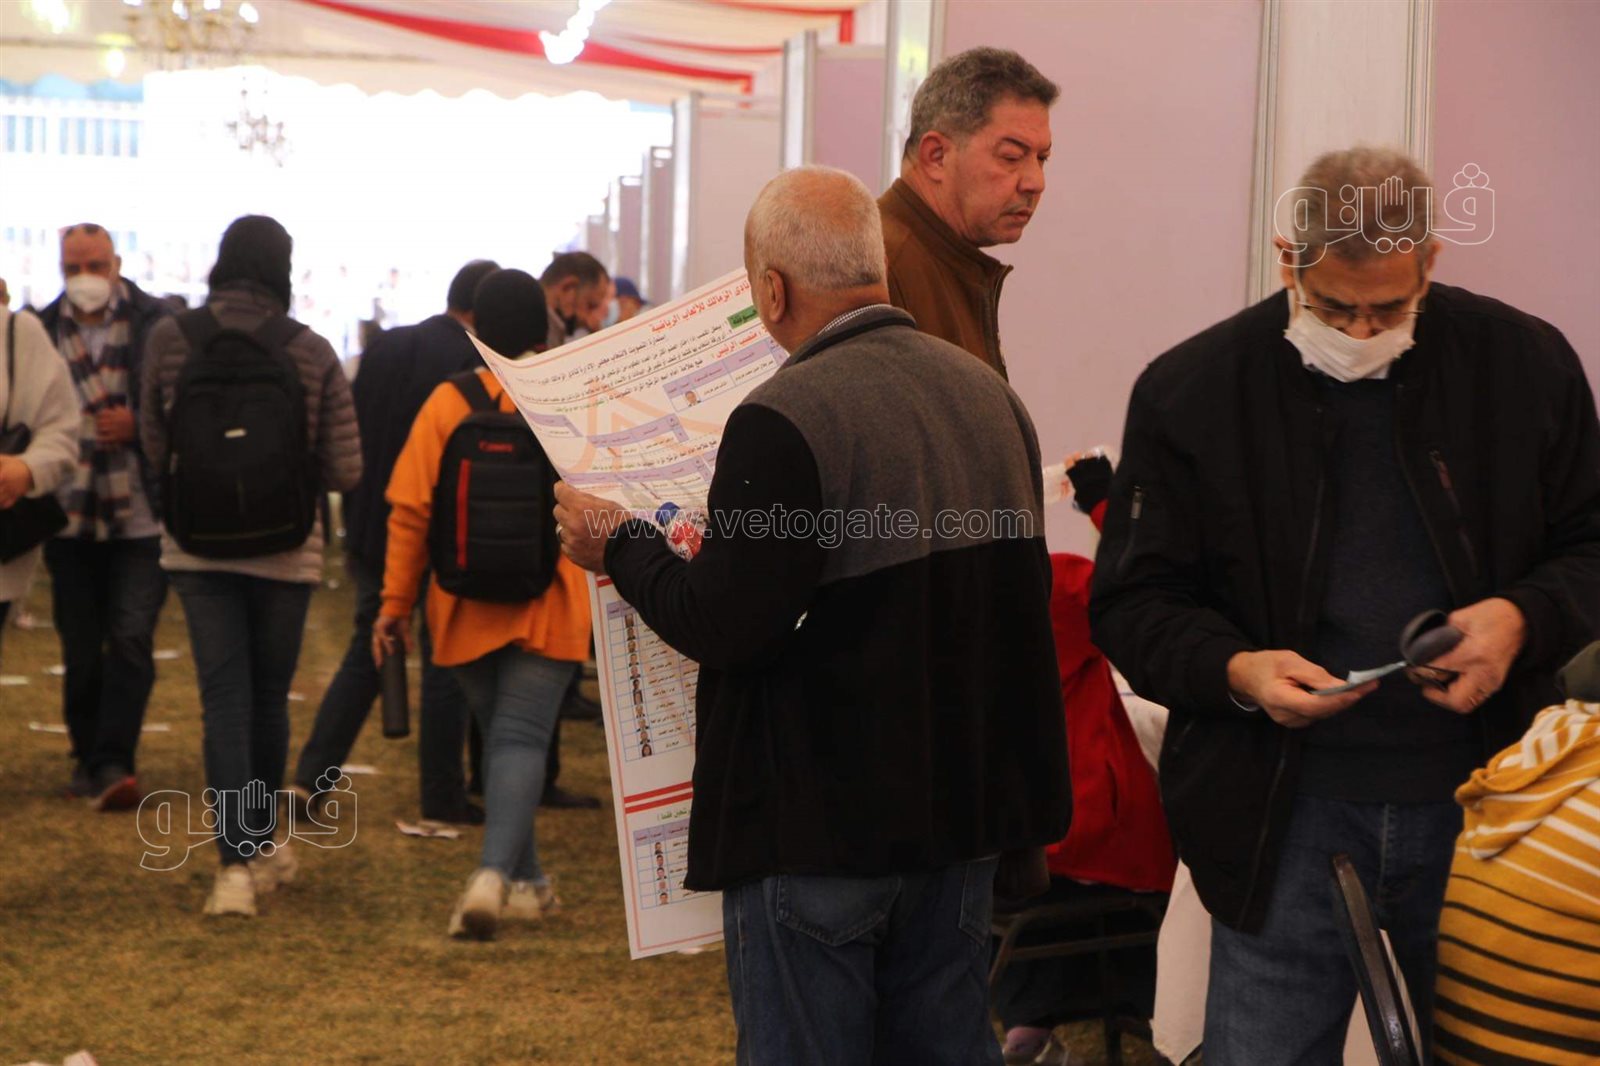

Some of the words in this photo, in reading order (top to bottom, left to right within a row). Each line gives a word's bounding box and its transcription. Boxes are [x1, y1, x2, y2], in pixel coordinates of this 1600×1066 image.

[707, 290, 732, 307] الزمالك
[652, 313, 681, 332] الرياضية
[716, 340, 737, 358] الرئيس
